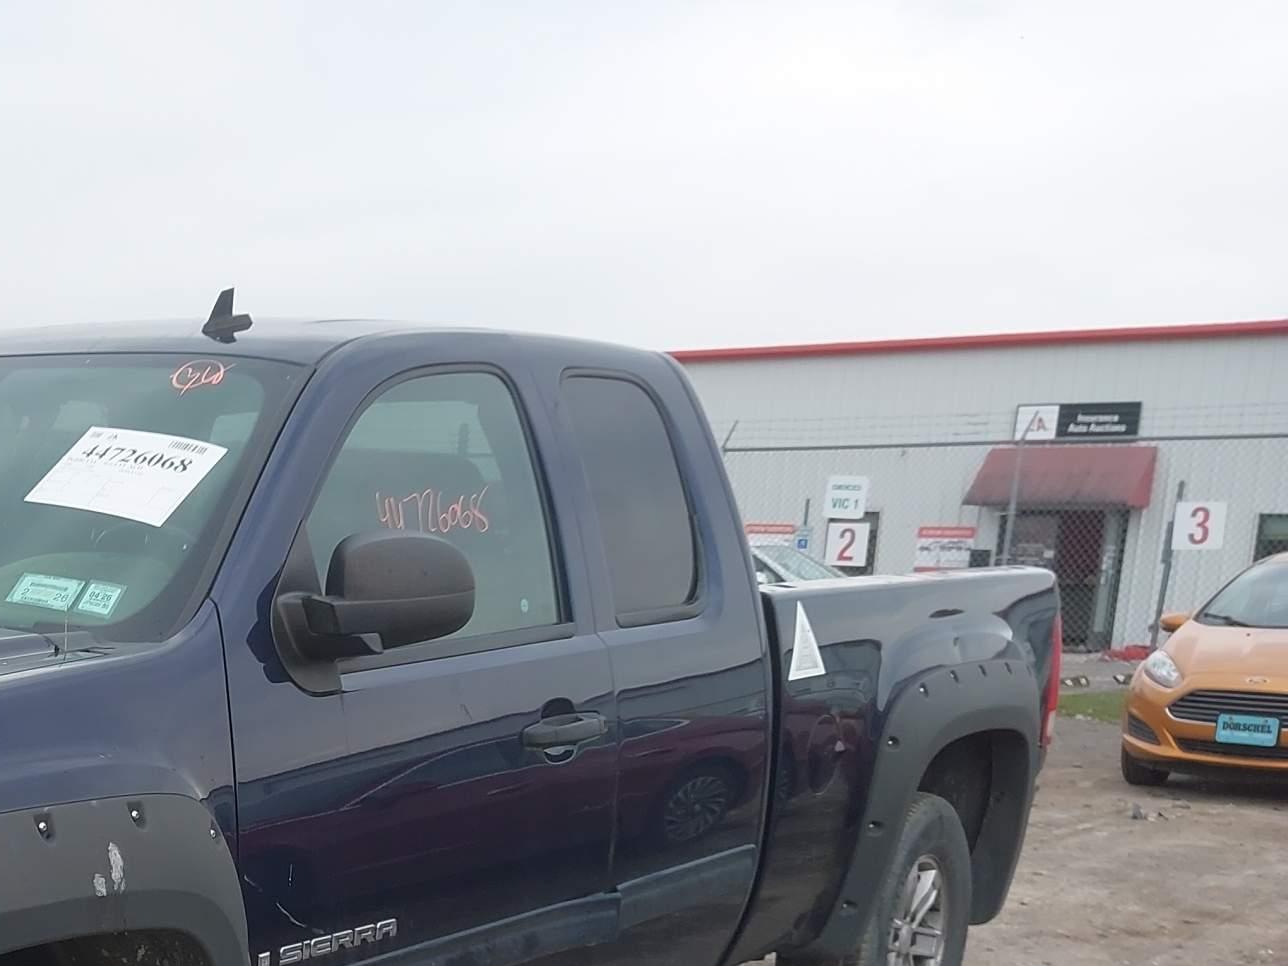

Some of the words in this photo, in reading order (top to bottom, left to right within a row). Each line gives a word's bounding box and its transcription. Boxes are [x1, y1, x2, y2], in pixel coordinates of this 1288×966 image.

[82, 444, 193, 473] 44726068
[832, 498, 850, 510] VIC
[1188, 506, 1210, 545] 3
[837, 527, 856, 561] 2
[1222, 721, 1273, 734] DORSCHEL
[279, 918, 397, 966] SIERRA
